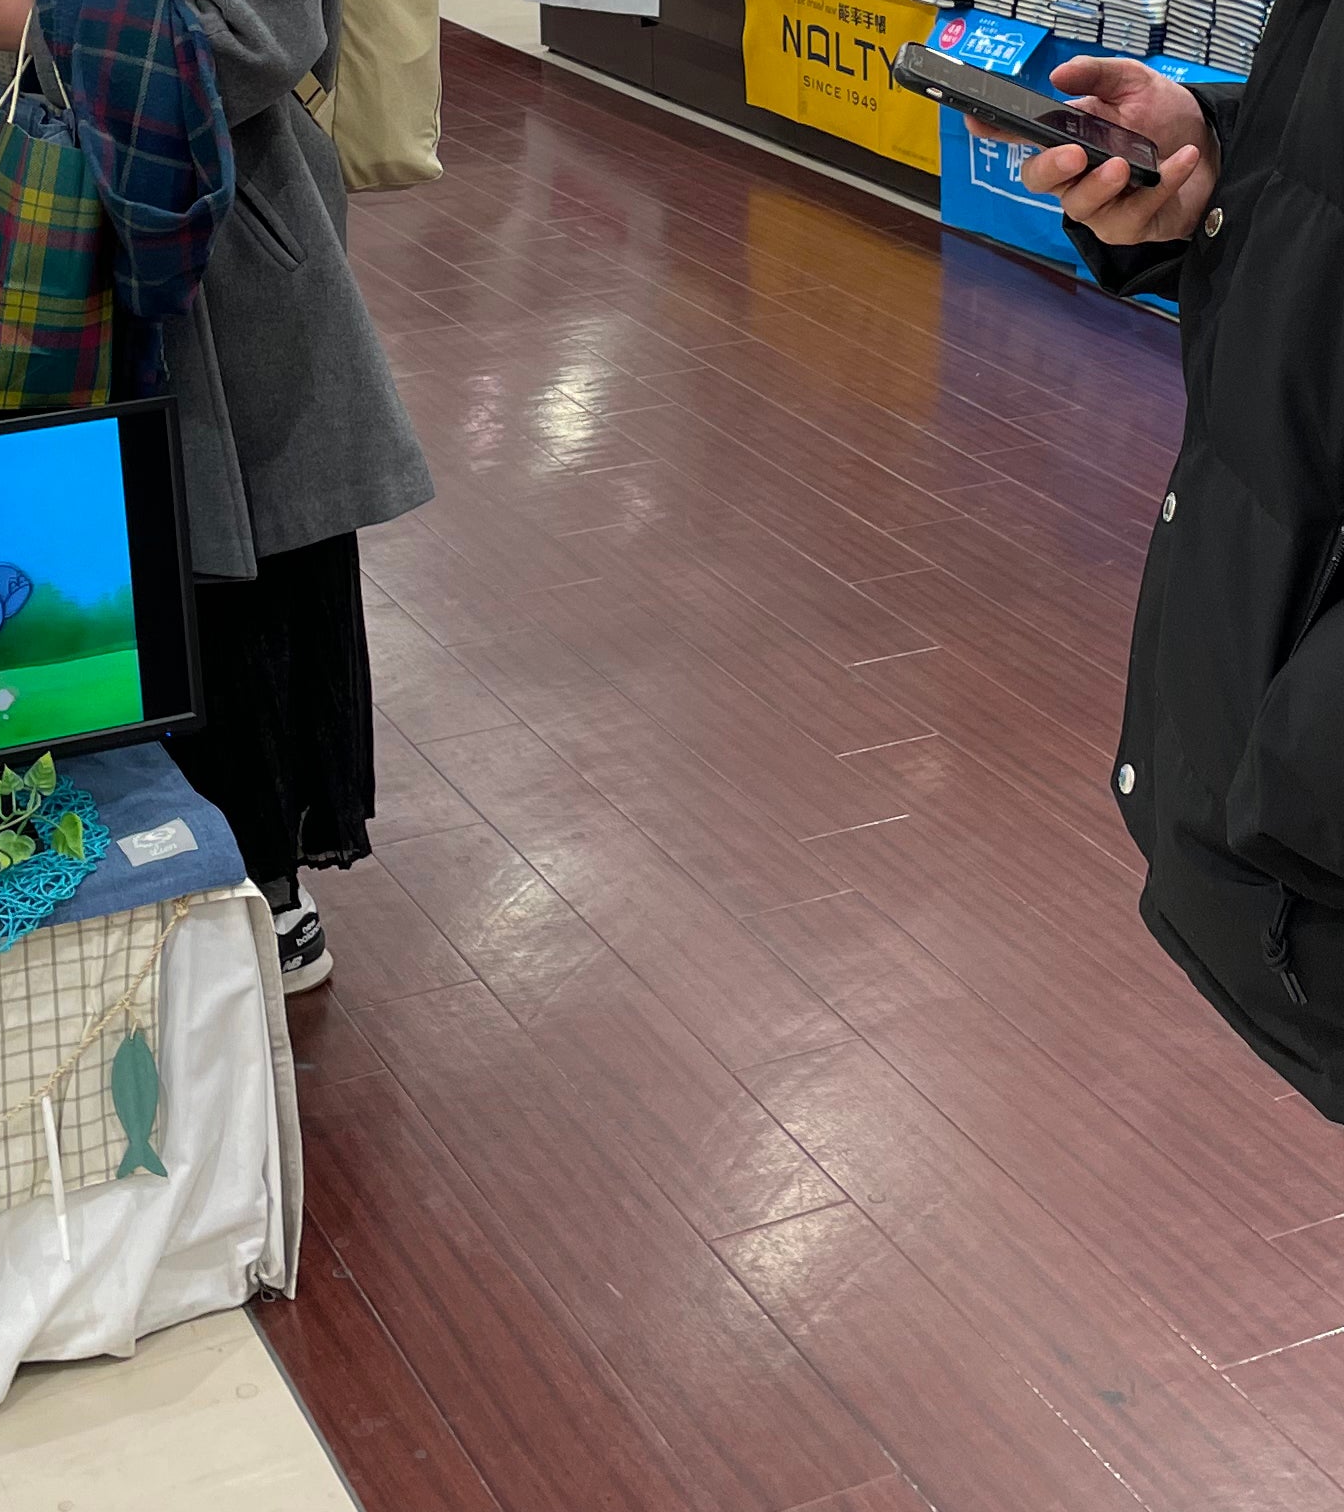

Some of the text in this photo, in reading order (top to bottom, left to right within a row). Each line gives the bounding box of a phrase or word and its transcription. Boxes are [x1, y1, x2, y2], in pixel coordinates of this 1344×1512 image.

[839, 2, 886, 34] 能率手帳
[783, 14, 898, 90] NOLTY
[803, 75, 877, 112] SINCE 1949
